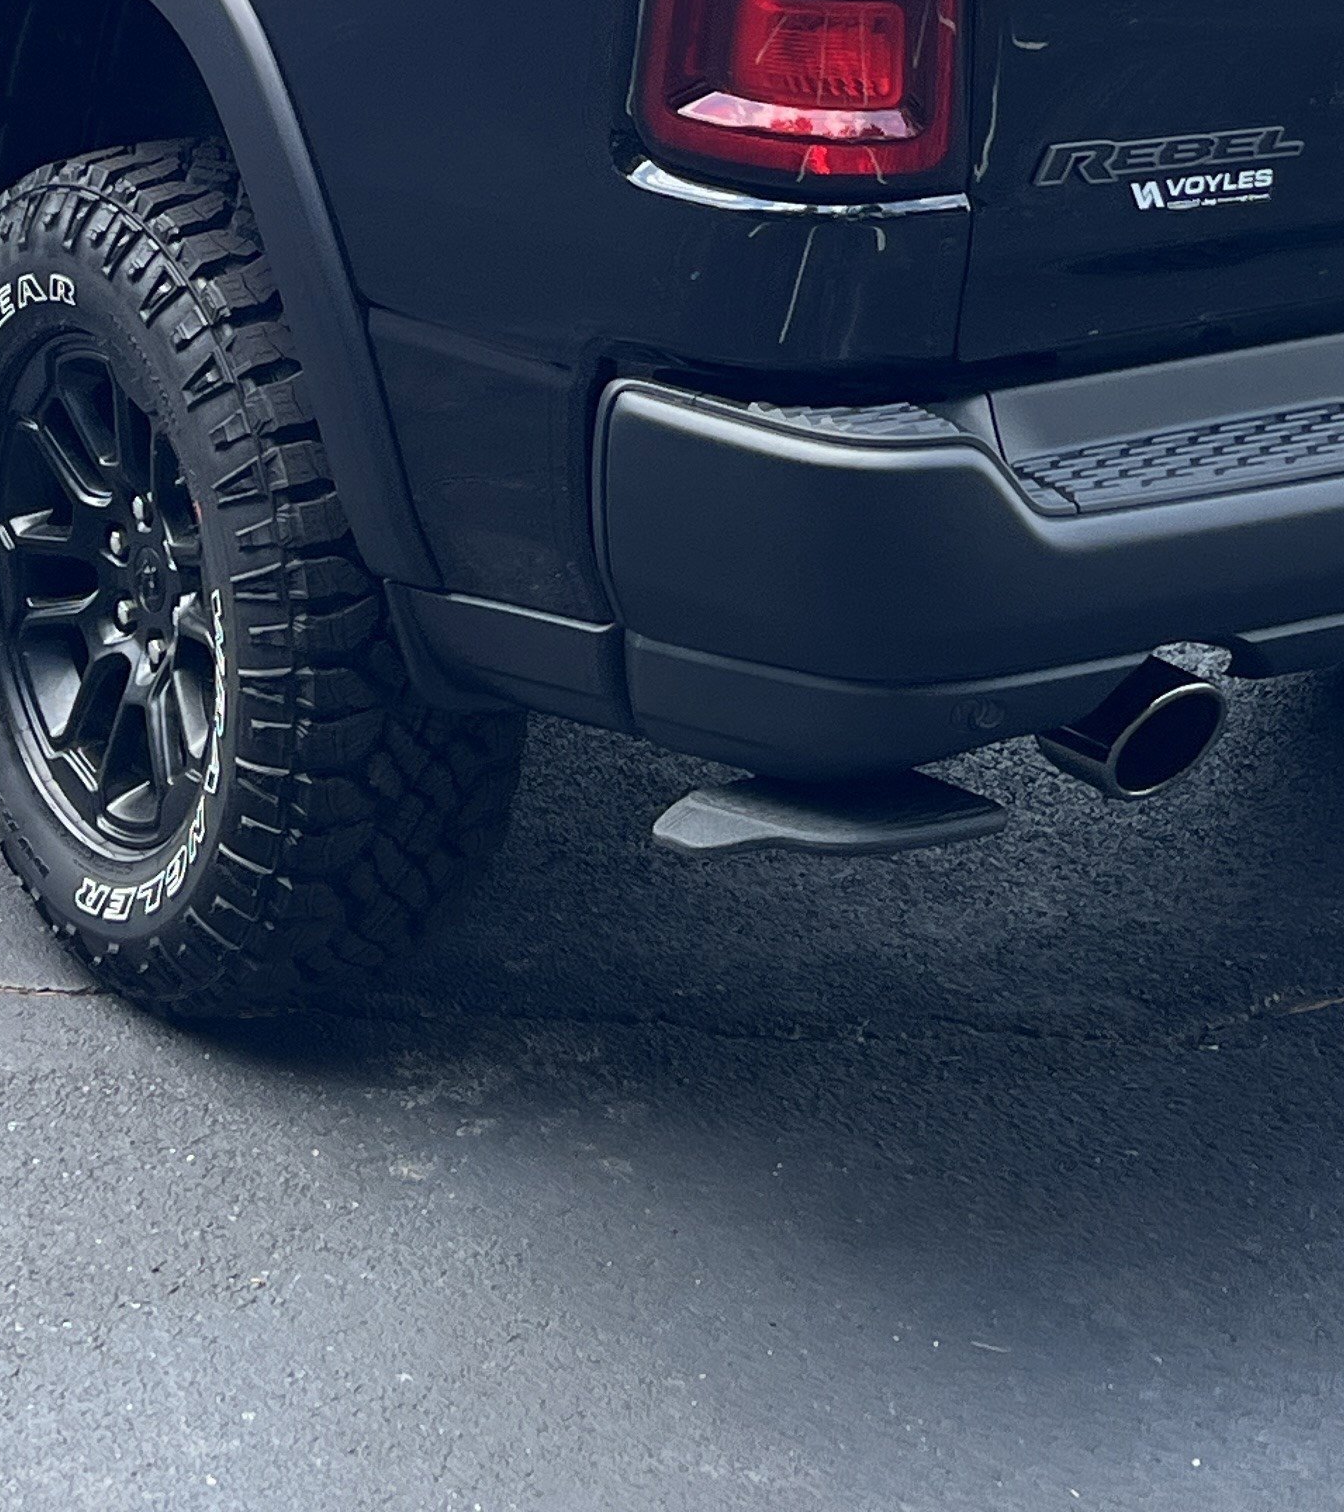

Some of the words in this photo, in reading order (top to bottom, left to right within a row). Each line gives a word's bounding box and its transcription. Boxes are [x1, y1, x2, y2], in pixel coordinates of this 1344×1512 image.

[1032, 125, 1305, 186] REBEL
[1165, 168, 1274, 197] VOYLES
[74, 588, 226, 921] WRANGLER
